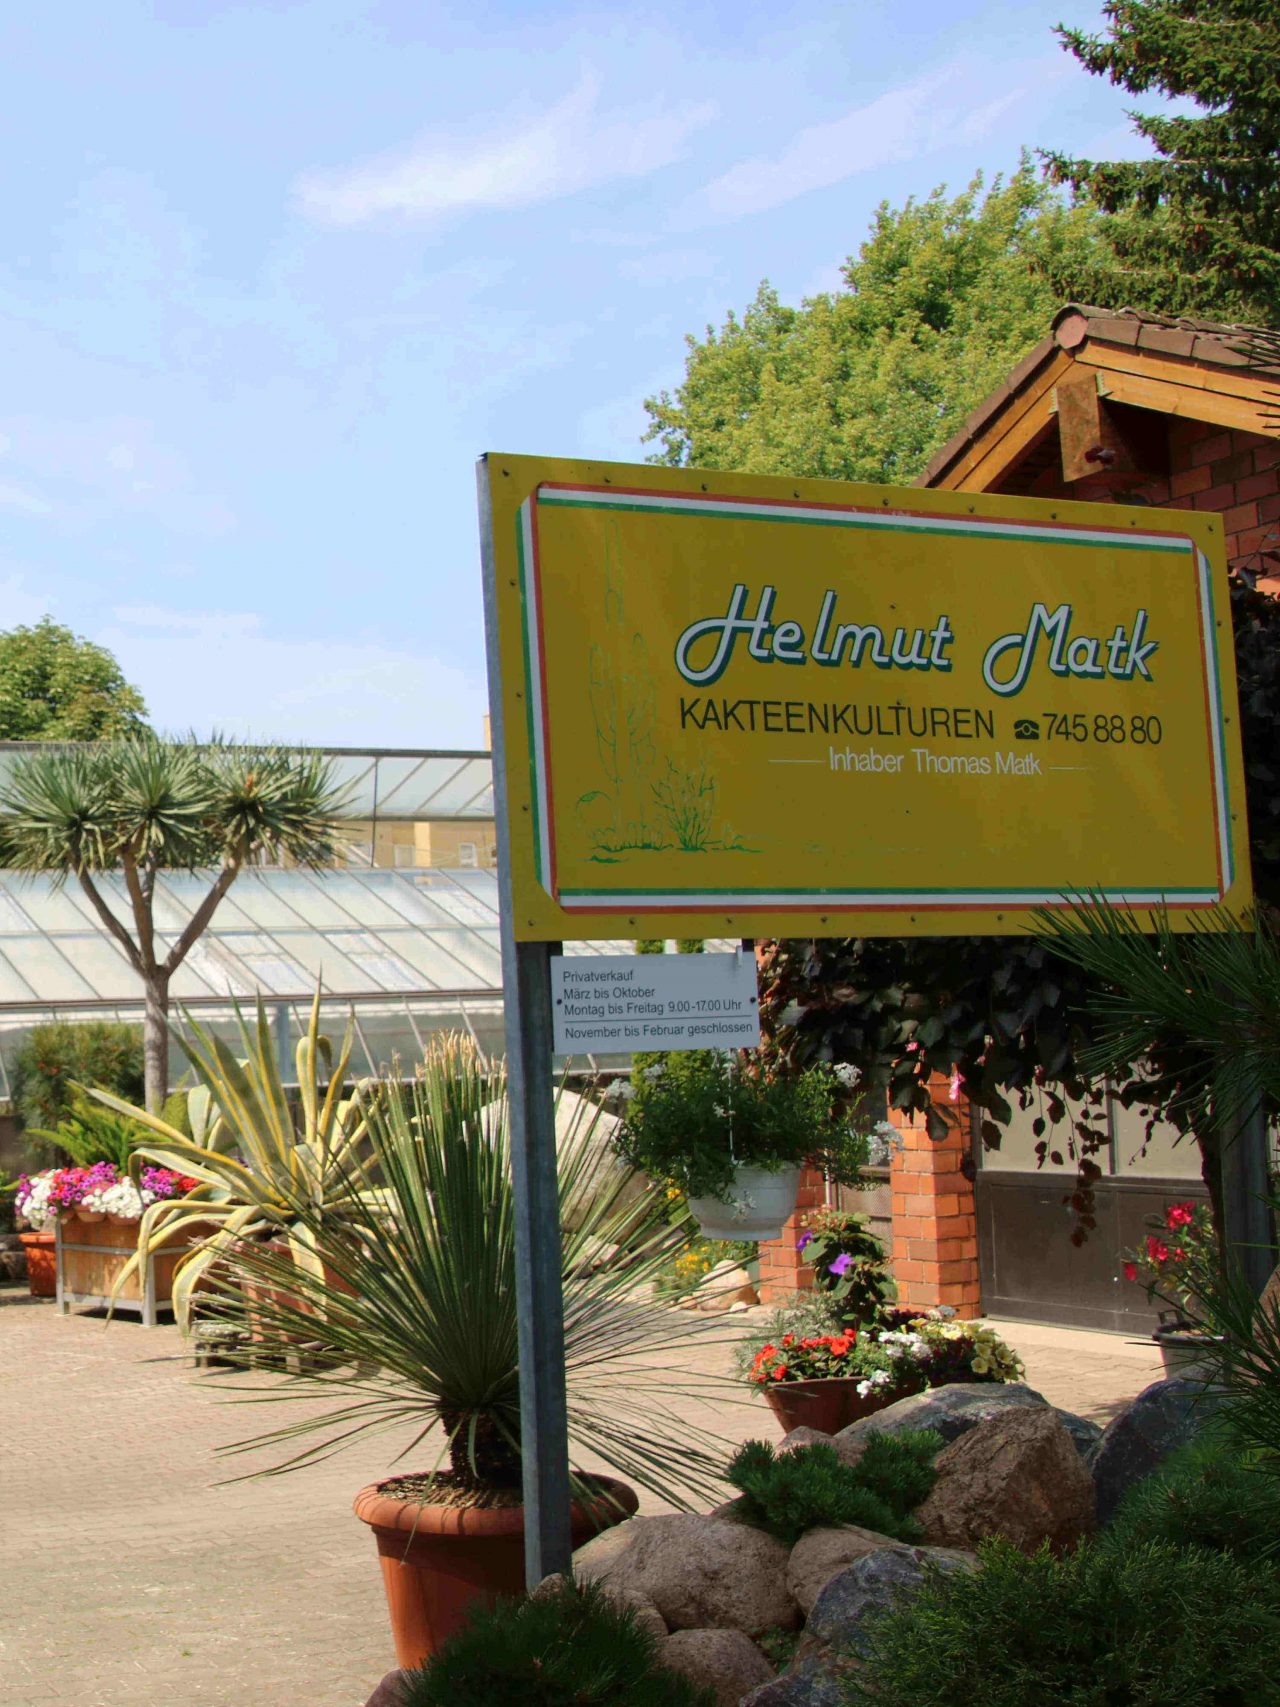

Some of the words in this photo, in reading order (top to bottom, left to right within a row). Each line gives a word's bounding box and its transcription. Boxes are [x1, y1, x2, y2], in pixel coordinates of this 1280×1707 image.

[675, 583, 954, 687] Helmut
[982, 602, 1160, 697] Matk
[680, 697, 995, 739] KAKTEENKULTUREN
[829, 746, 904, 773] Inhaber
[911, 748, 991, 774] Thomas
[994, 751, 1042, 775] Matk
[563, 969, 633, 983] Privatverkauf
[564, 988, 591, 1000] März
[594, 988, 609, 999] bis
[613, 986, 655, 999] Oktober
[564, 1003, 605, 1017] Montag
[608, 1002, 623, 1014] bis
[627, 1000, 664, 1015] Freitag
[723, 999, 742, 1011] Uhr
[565, 1025, 621, 1039] November
[625, 1025, 639, 1036] bis
[643, 1023, 684, 1036] Februar
[688, 1021, 753, 1037] geschlossen
